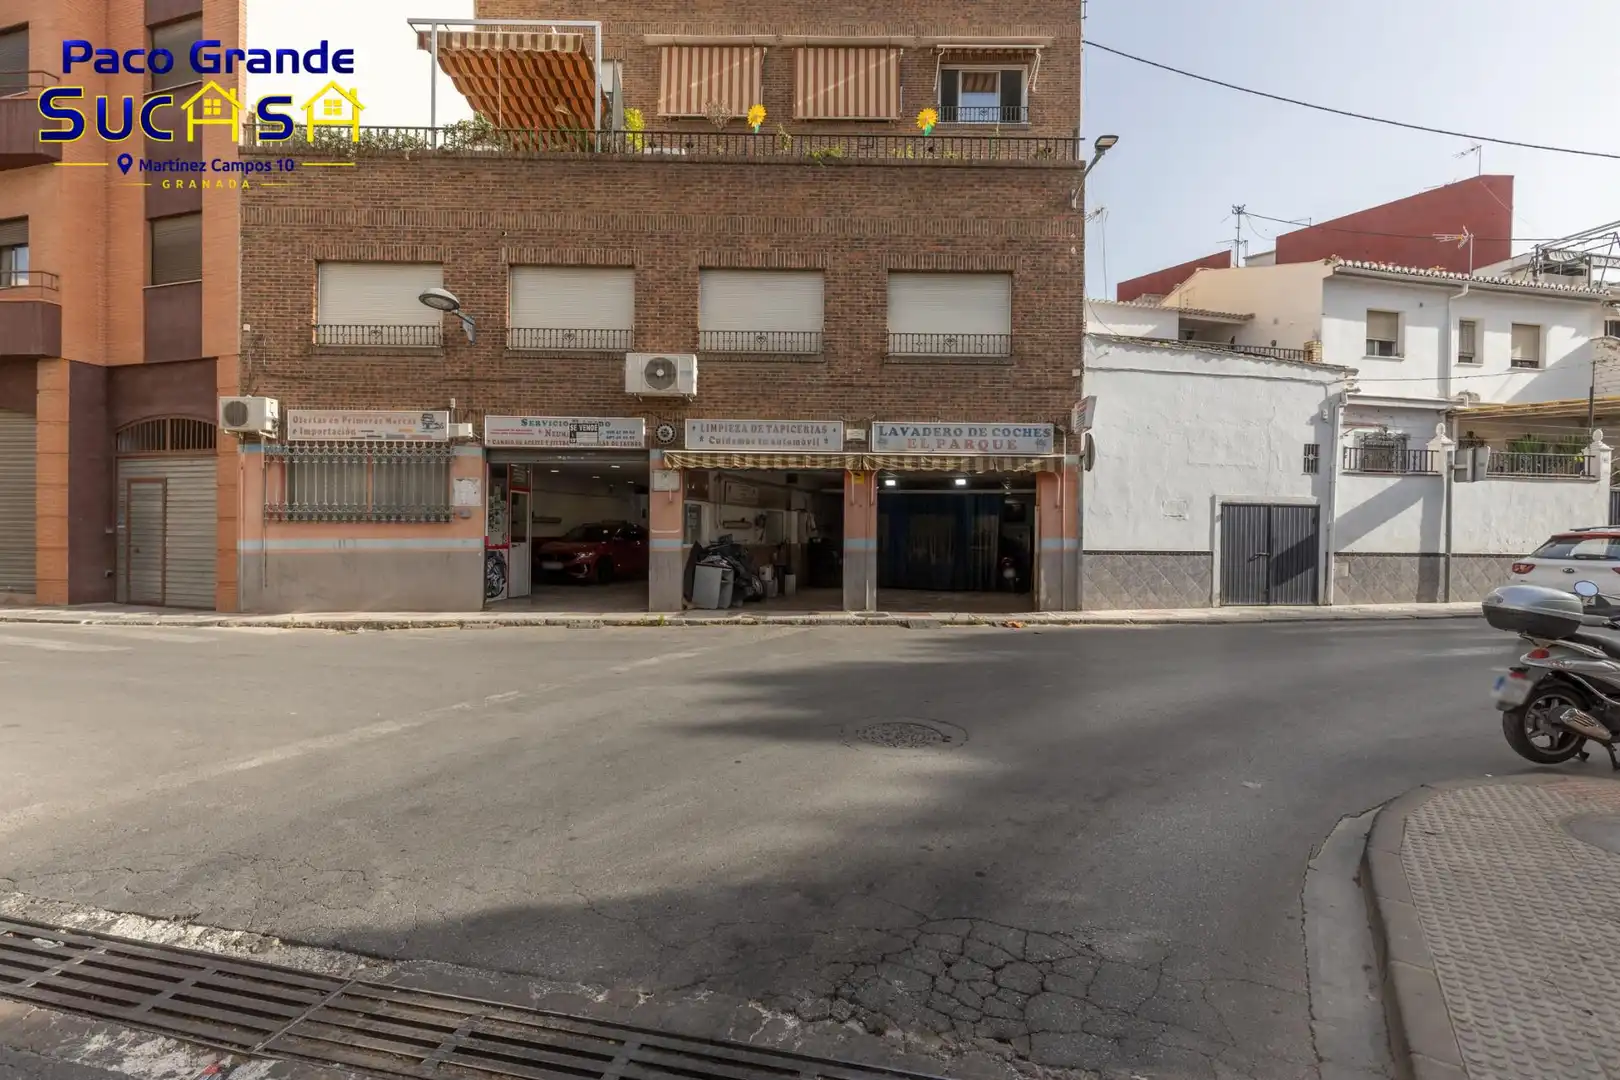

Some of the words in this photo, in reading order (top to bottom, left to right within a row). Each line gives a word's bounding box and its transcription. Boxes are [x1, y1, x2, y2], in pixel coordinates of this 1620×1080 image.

[520, 418, 569, 428] SERVICIO
[700, 423, 748, 434] LIMPIEZA
[750, 424, 765, 434] DE
[878, 426, 963, 438] LAVADERO
[968, 427, 988, 438] DE
[992, 427, 1051, 438] COCHES
[907, 438, 930, 449] EL
[935, 438, 1017, 452] PARQUE
